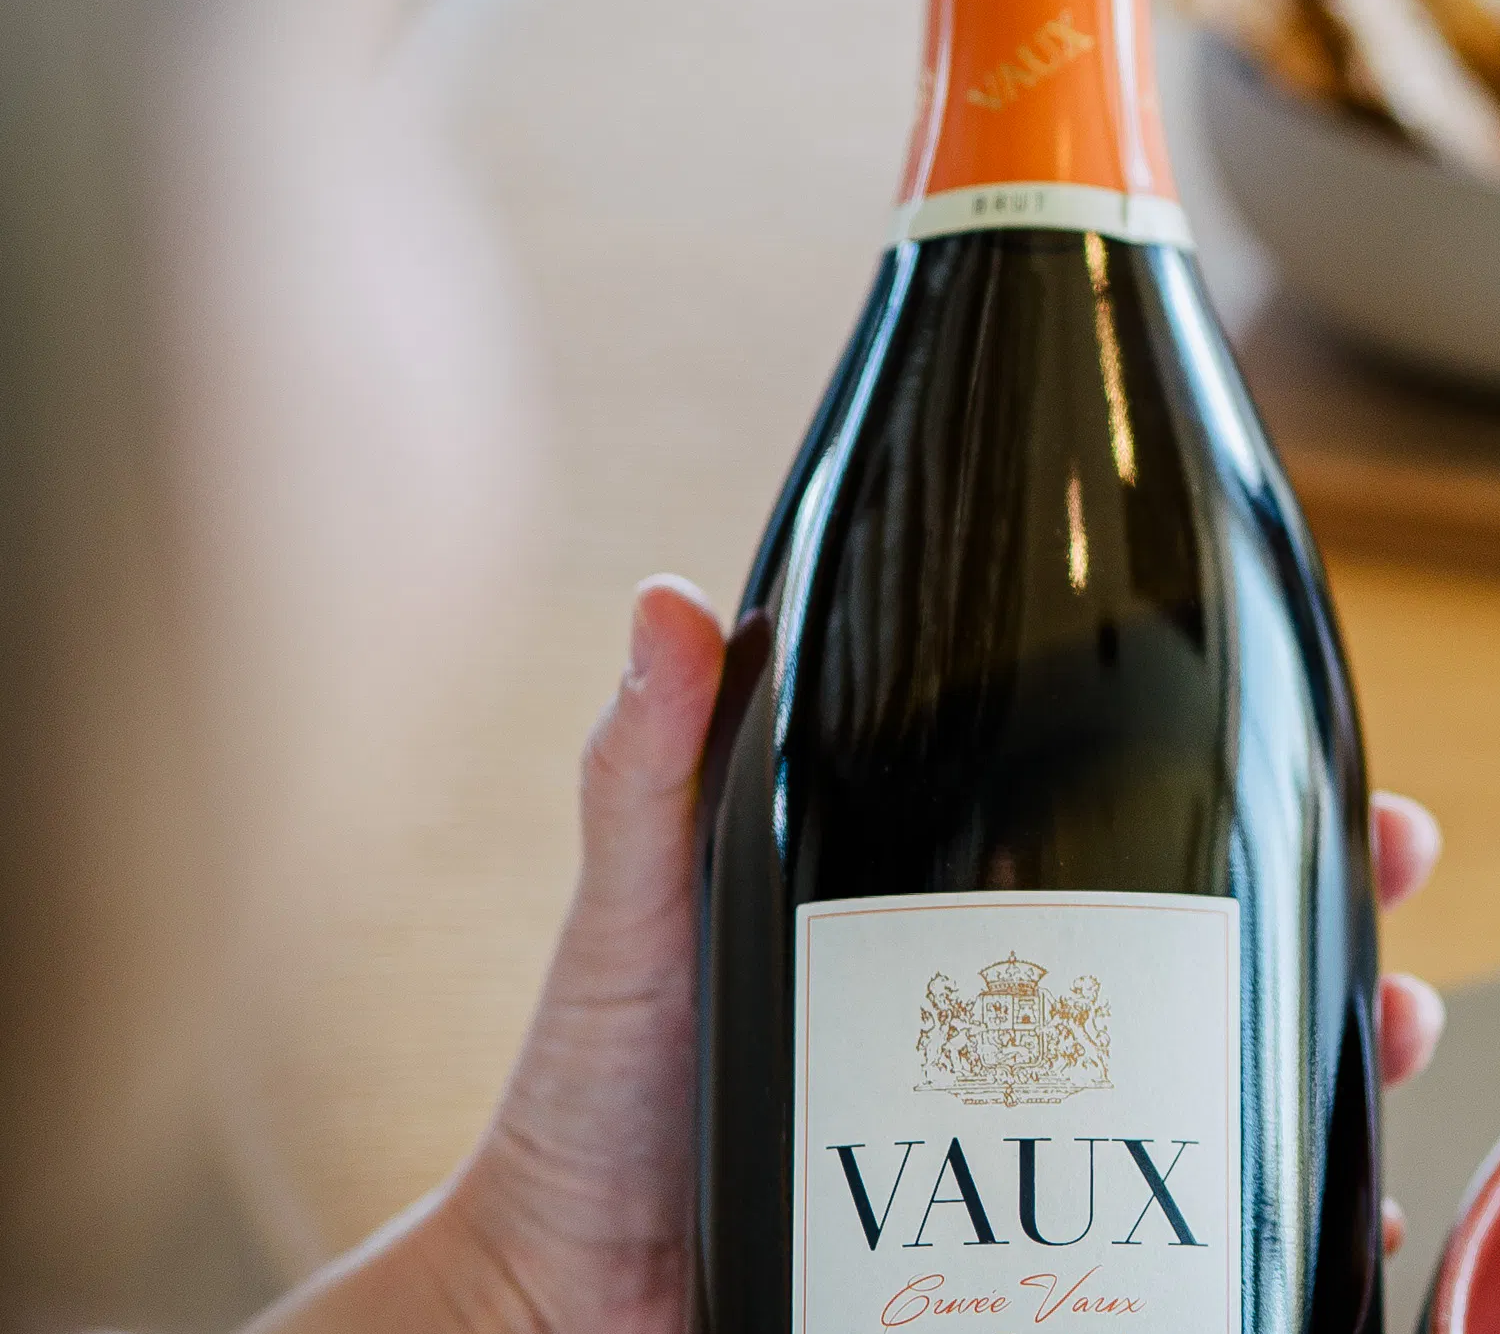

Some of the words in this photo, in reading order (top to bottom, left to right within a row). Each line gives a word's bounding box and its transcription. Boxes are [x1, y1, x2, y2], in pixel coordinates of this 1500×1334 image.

[966, 9, 1096, 110] VAUX
[826, 1137, 1208, 1251] VAUX
[1019, 1265, 1146, 1323] Vaux
